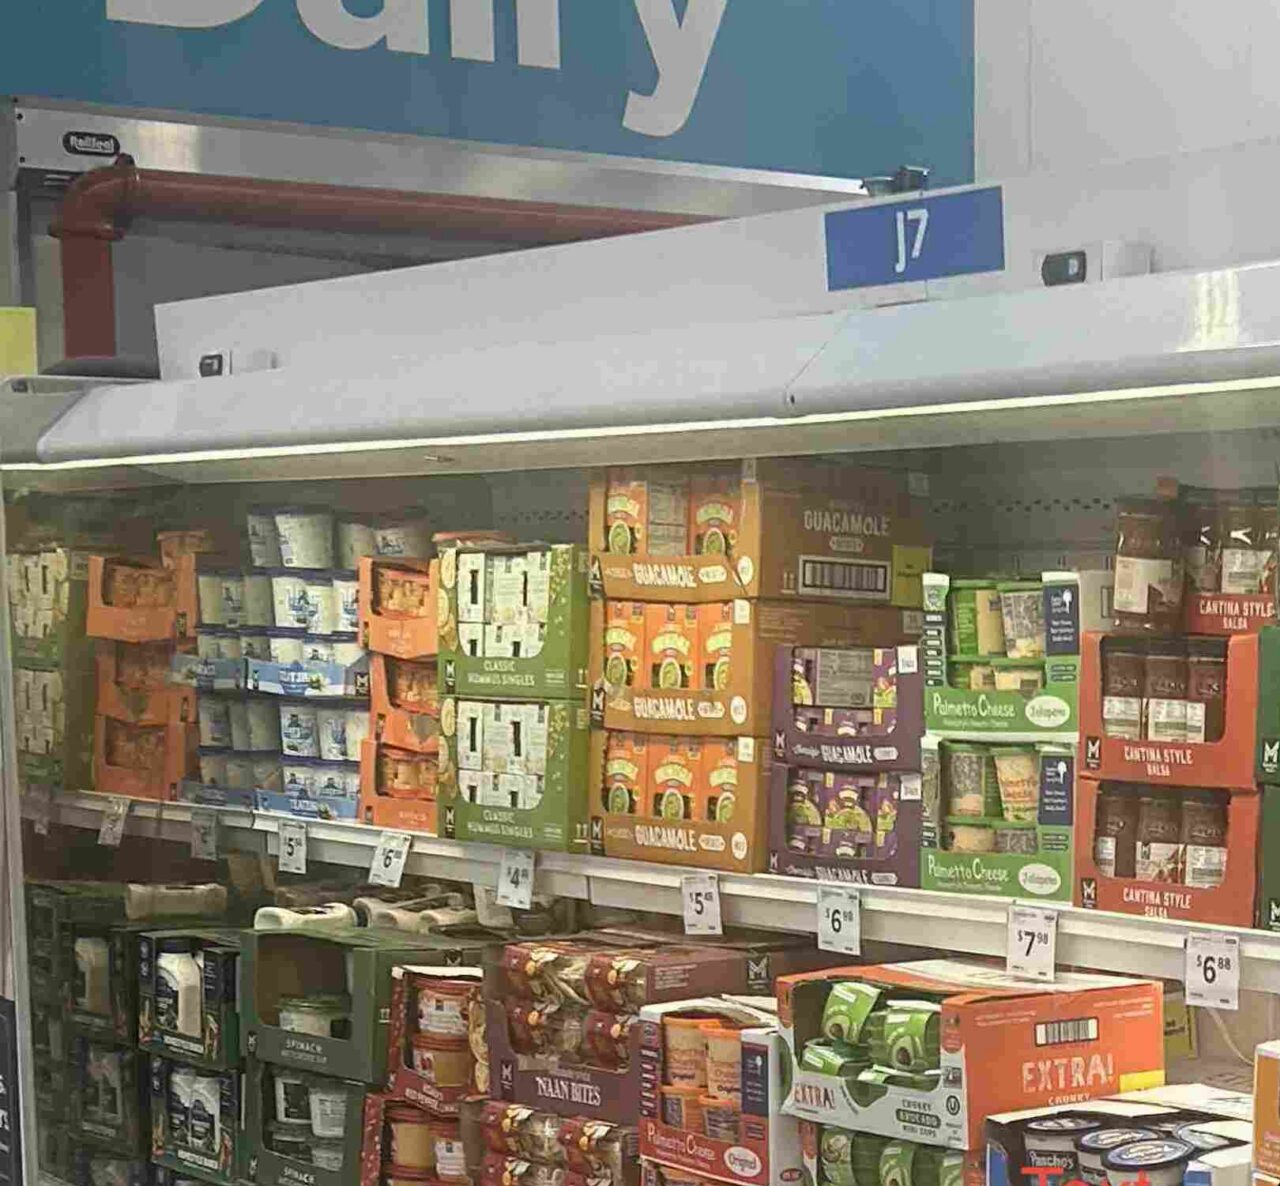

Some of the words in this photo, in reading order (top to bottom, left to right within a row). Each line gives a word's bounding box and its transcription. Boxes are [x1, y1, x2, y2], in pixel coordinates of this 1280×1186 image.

[895, 209, 928, 273] J7
[803, 510, 891, 537] GUACAMOLE
[1200, 598, 1241, 617] CANTINA
[1243, 601, 1274, 619] STYLE
[1223, 617, 1248, 630] SALSA
[933, 693, 976, 717] Palmetto
[978, 696, 1017, 718] Cheese
[1123, 747, 1161, 763] CANTINA
[1163, 748, 1194, 766] STYLE
[634, 825, 698, 852] GUACAMOLE
[928, 854, 972, 879] Palmetto
[973, 858, 1010, 882] Cheese
[1123, 887, 1162, 905] CANTINA
[1163, 890, 1192, 908] STYLE
[1022, 1053, 1115, 1093] EXTRA!
[536, 1076, 569, 1099] NAAN
[571, 1080, 601, 1106] BITES
[794, 1081, 836, 1110] EXTRA!
[1029, 1152, 1075, 1169] Pancho's
